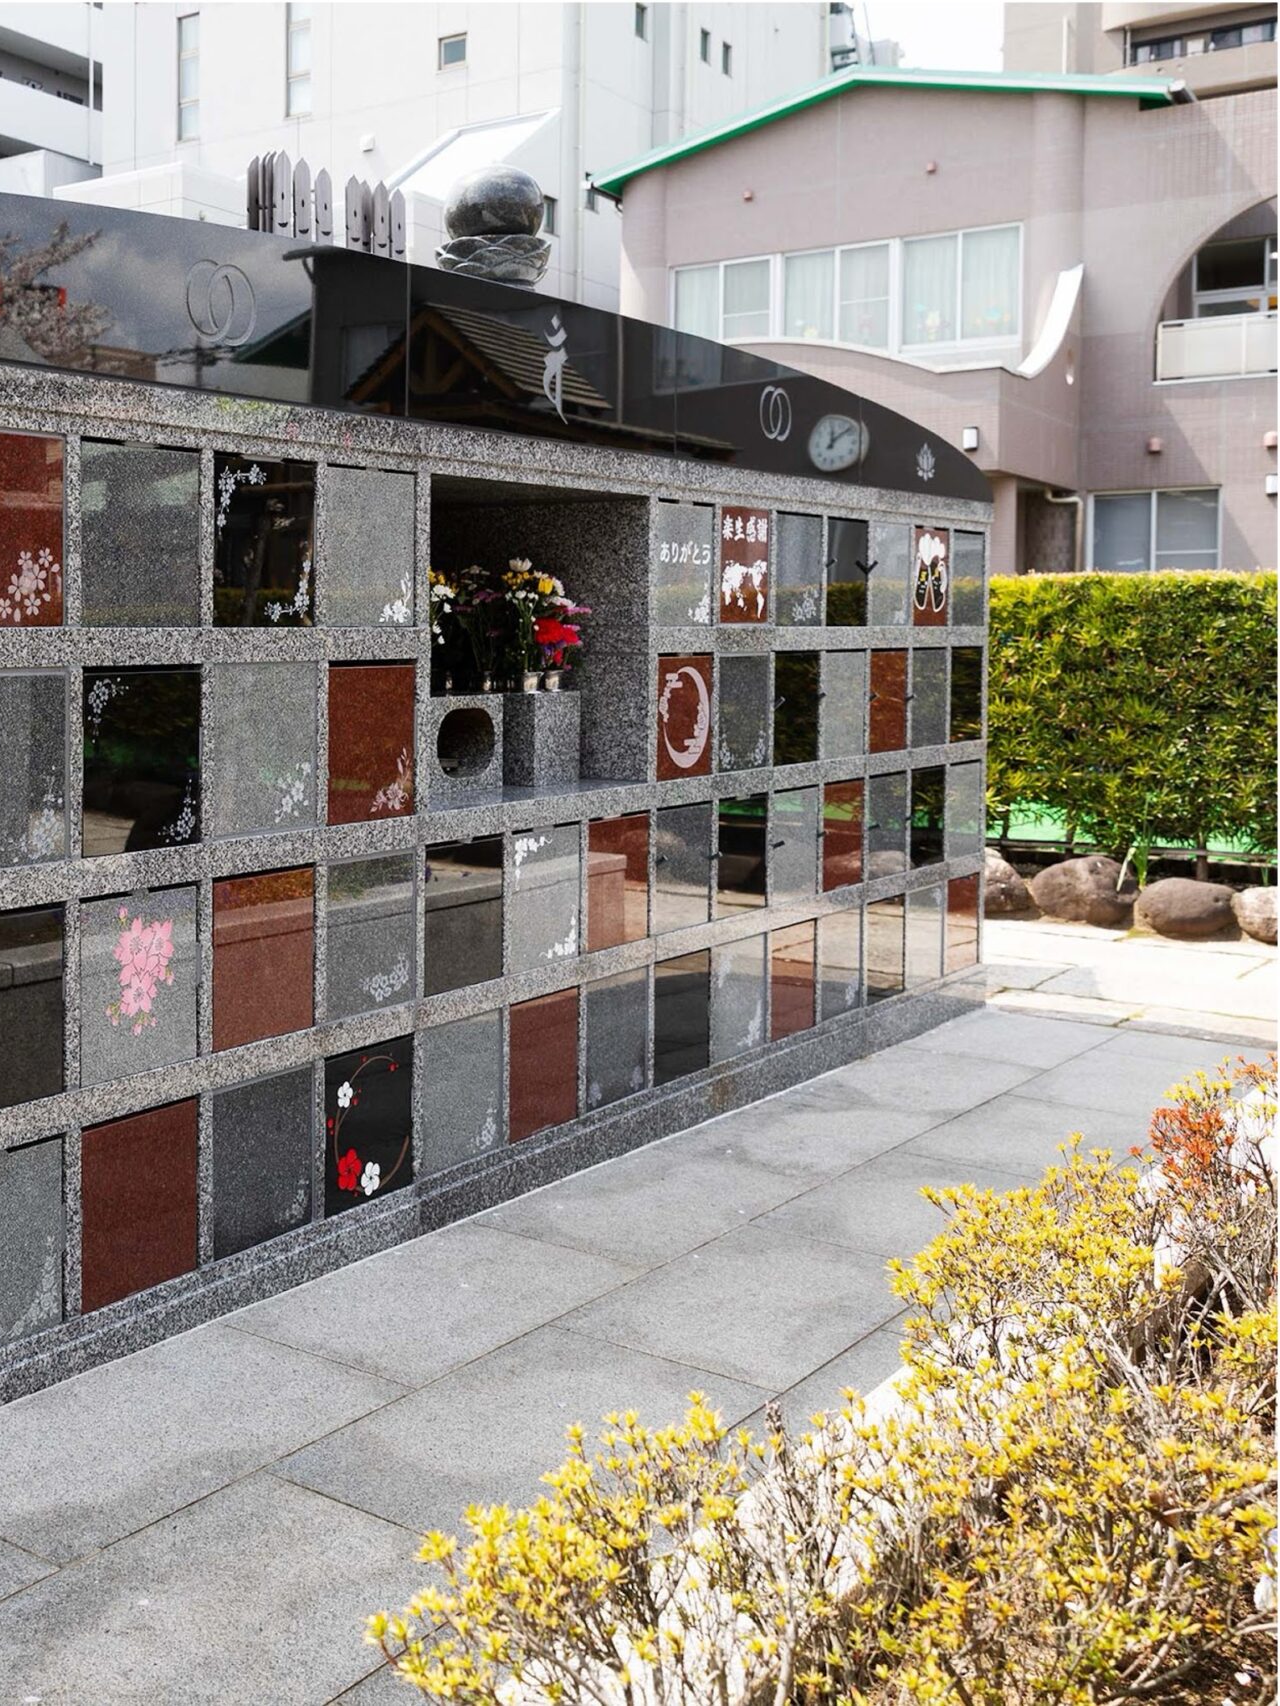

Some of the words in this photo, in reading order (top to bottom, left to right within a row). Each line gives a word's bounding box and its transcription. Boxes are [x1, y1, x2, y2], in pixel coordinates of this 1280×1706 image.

[659, 540, 711, 565] ありがとう
